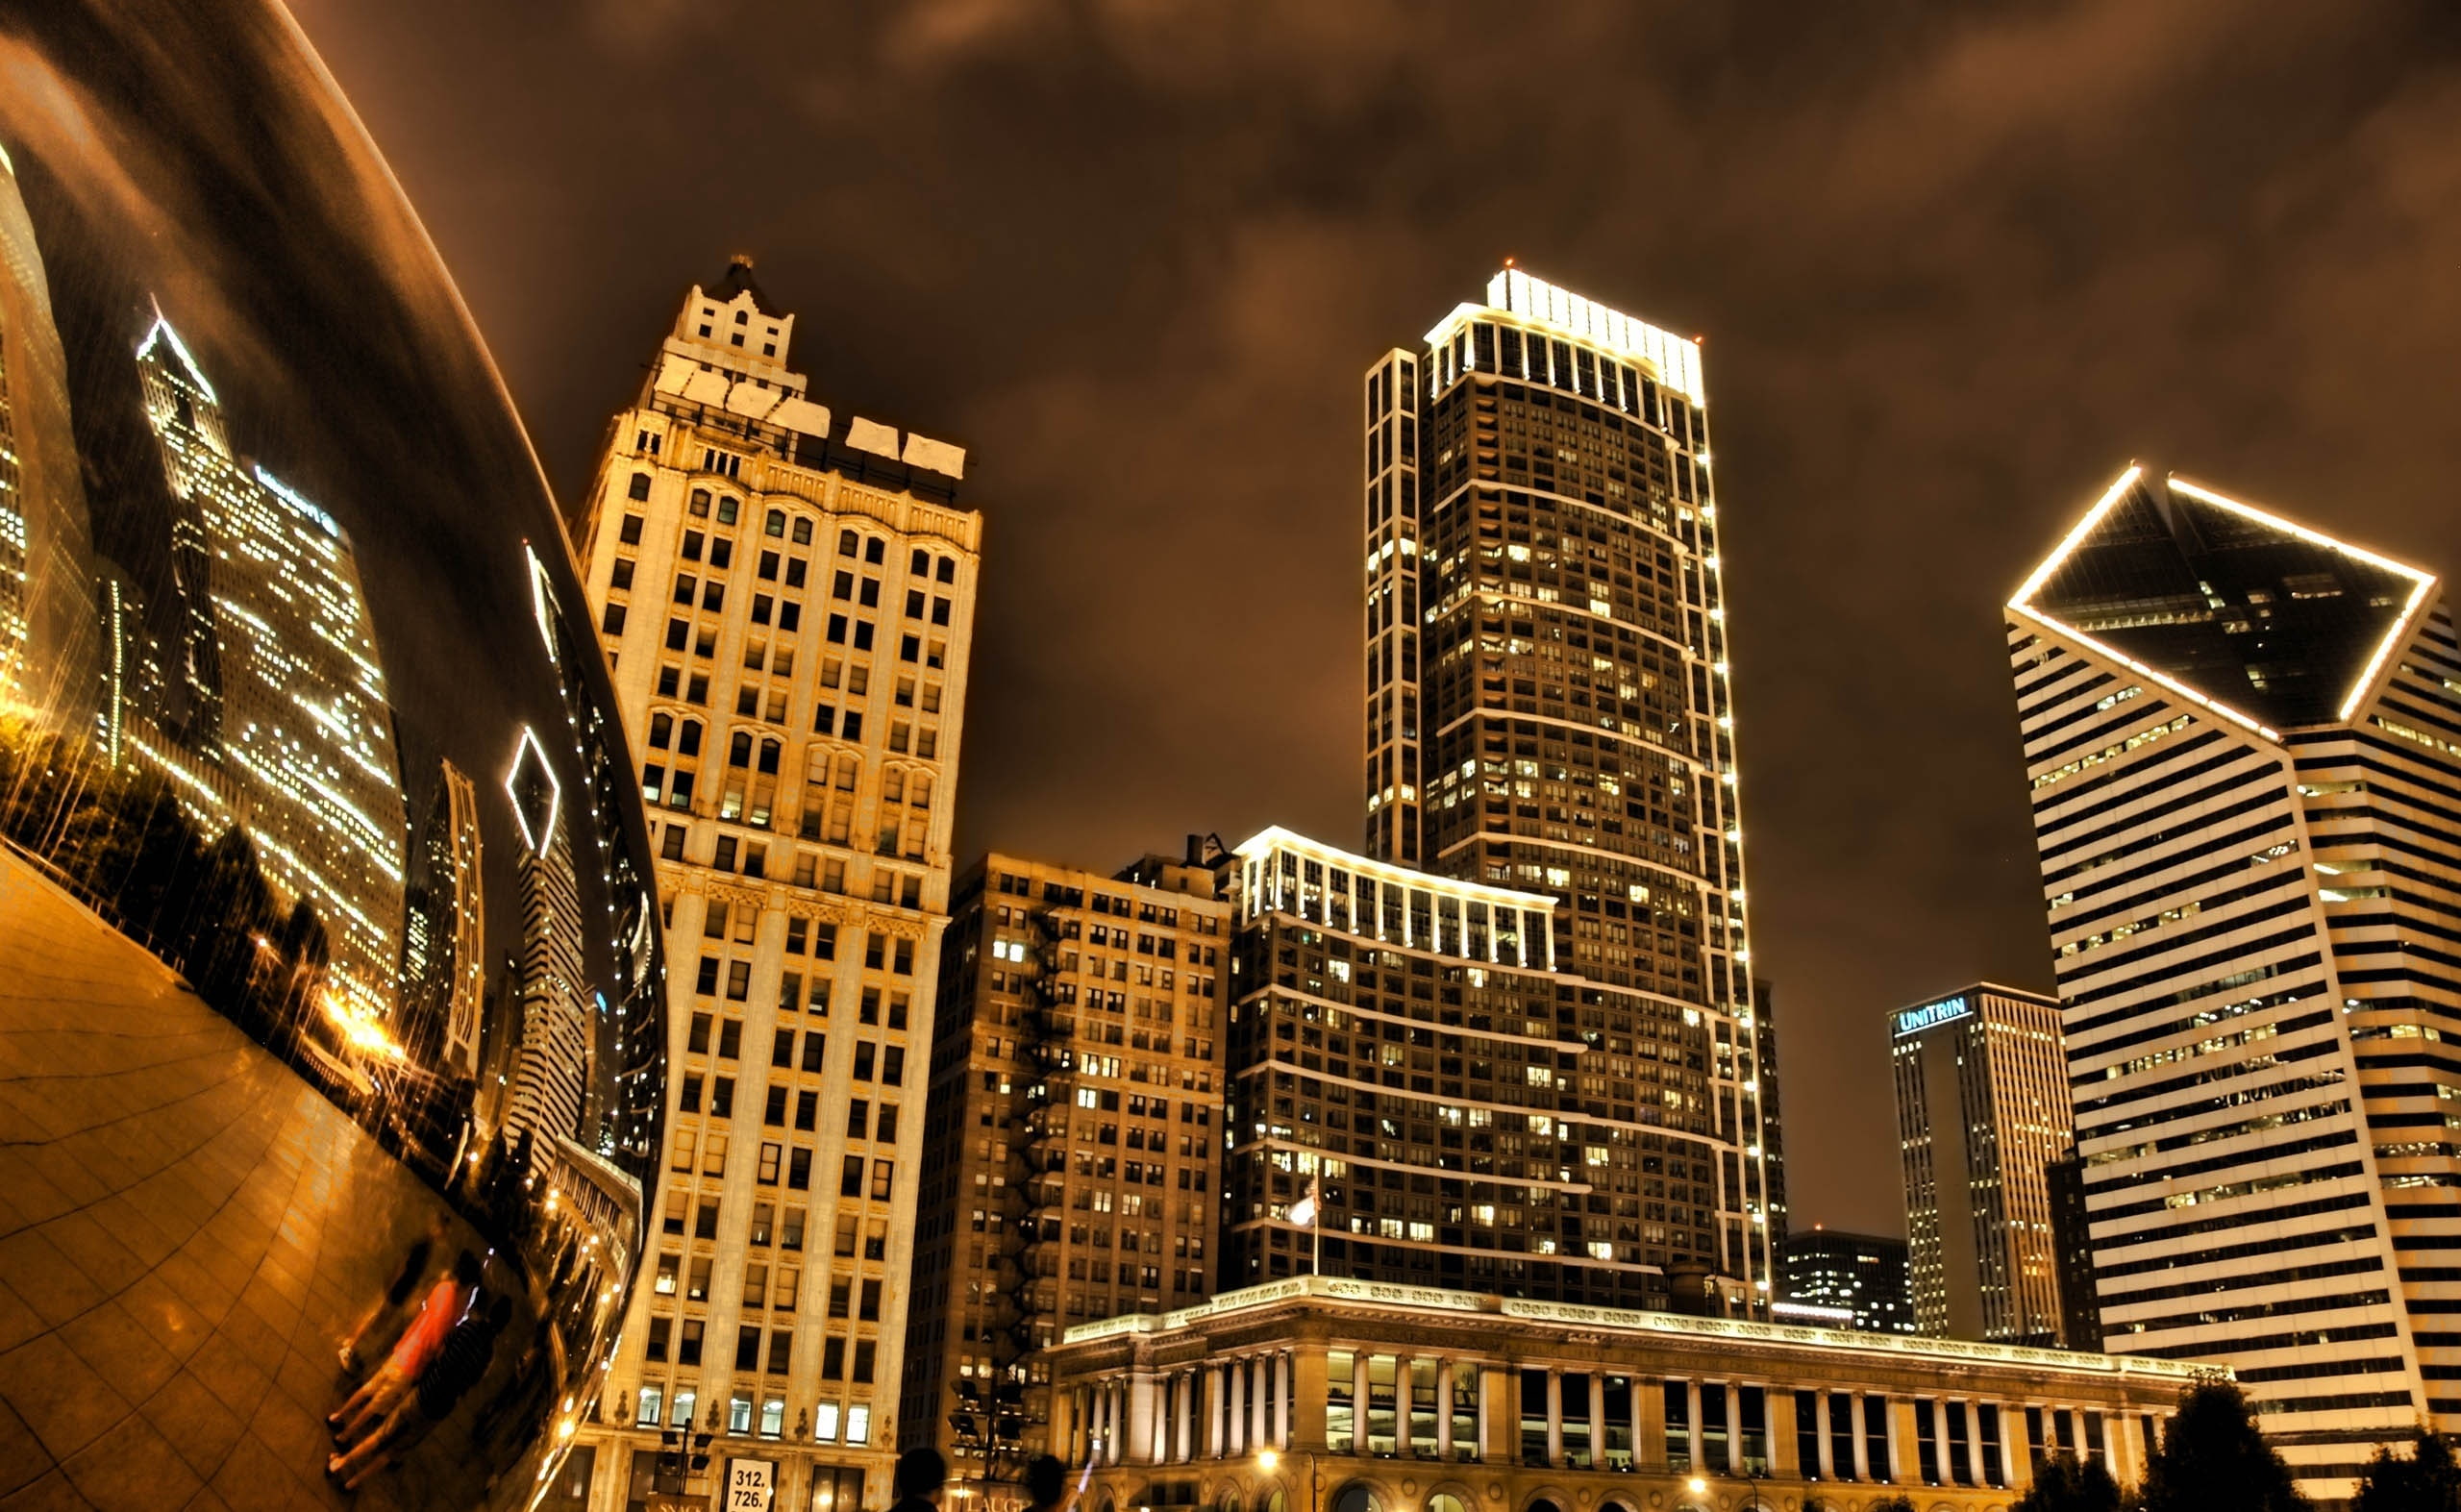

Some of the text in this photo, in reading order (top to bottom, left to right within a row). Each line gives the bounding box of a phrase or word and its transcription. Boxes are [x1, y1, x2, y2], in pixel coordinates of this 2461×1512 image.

[1900, 997, 1965, 1031] UNITRIN
[735, 1470, 765, 1487] 312.
[734, 1490, 763, 1507] 726.
